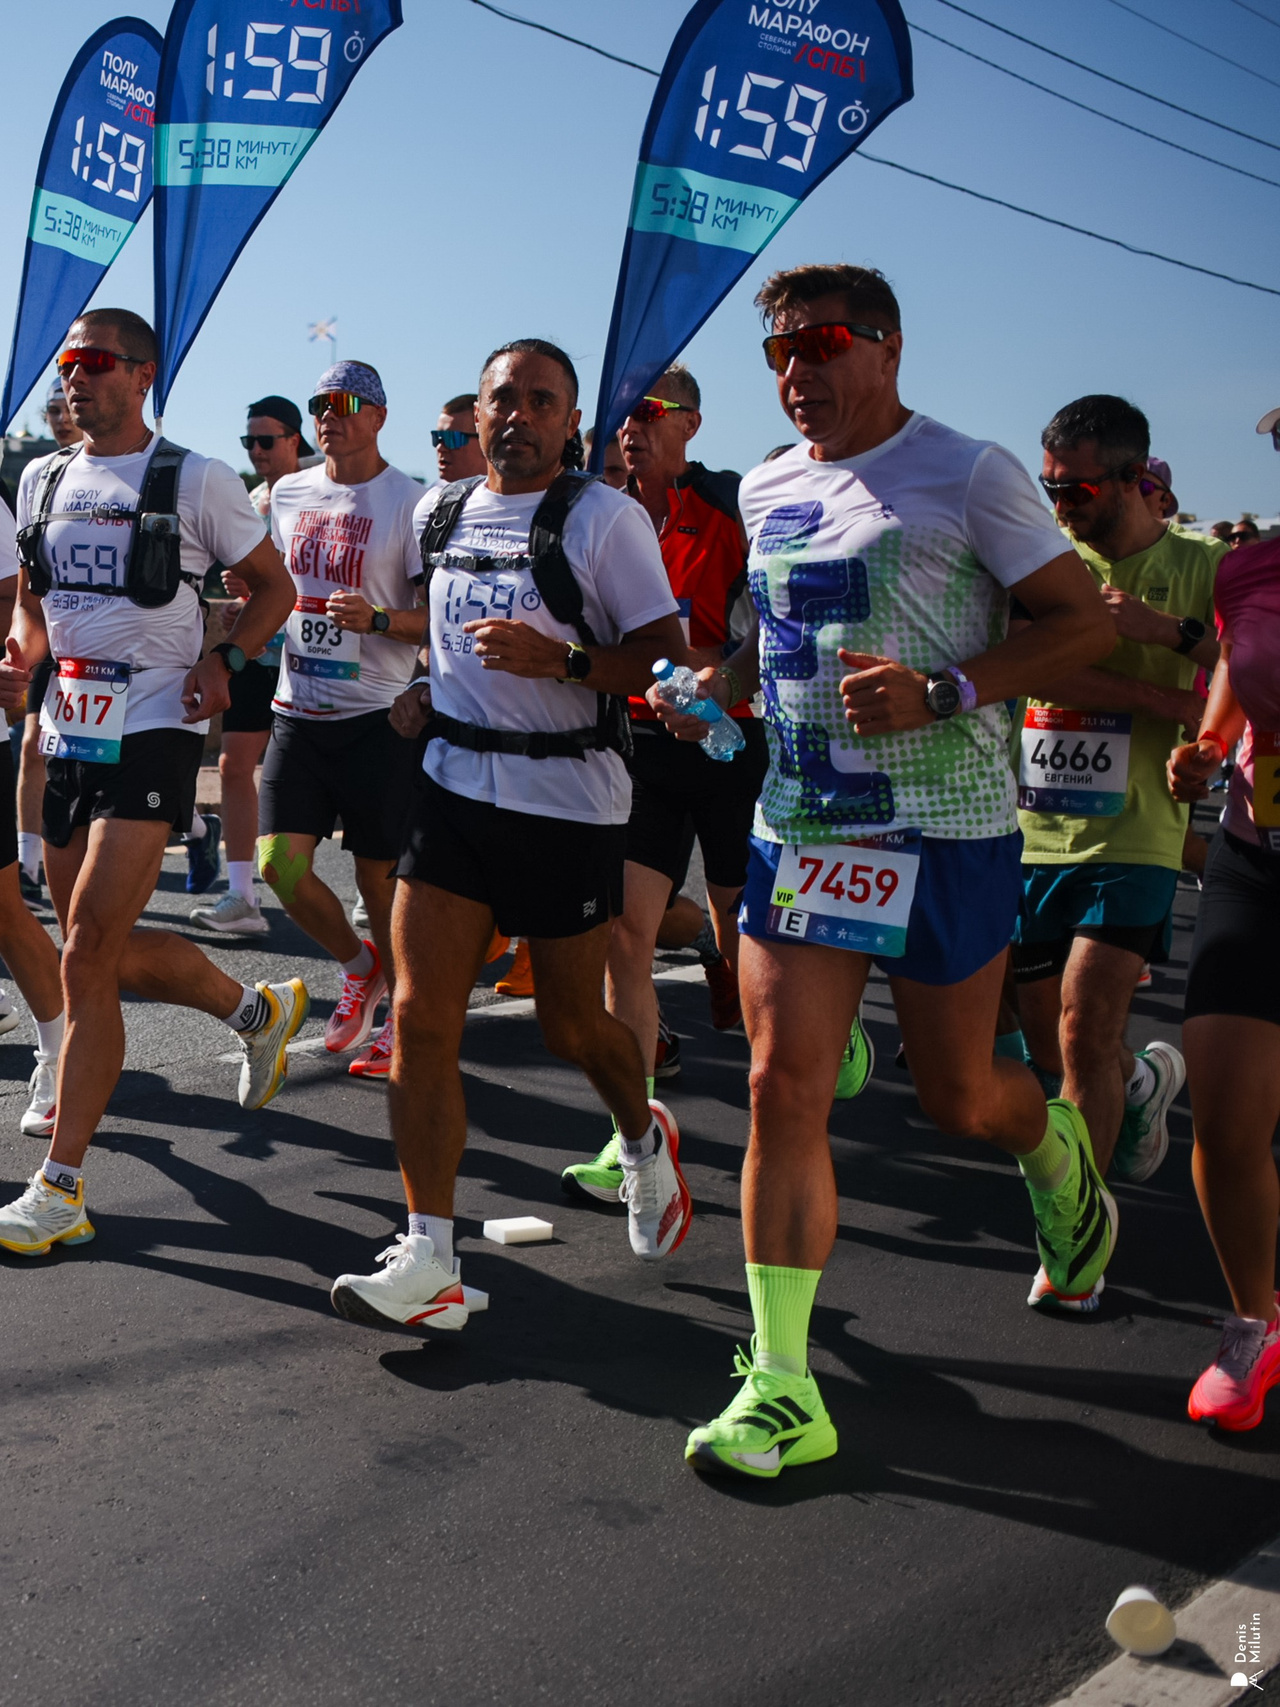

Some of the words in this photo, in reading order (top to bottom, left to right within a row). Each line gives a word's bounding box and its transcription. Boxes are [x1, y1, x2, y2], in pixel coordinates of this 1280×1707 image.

[748, 4, 870, 56] МАРАФОН
[759, 32, 797, 48] СЕВЕРНАЯ
[757, 41, 792, 56] СТОЛИЦА
[102, 50, 139, 80] ПОЛУ
[206, 22, 332, 104] 1:59
[100, 69, 156, 109] МАРАФО
[694, 65, 828, 173] 1:59
[71, 115, 146, 203] 1:59
[179, 138, 231, 170] 5:38
[235, 155, 258, 170] КМ
[650, 183, 709, 225] 5:38
[44, 205, 83, 242] 5:38
[711, 215, 738, 232] КМ
[81, 233, 96, 249] КМ
[67, 489, 102, 500] ПОЛУ
[472, 525, 510, 538] ПОЛУ
[50, 544, 118, 587] 1:59
[291, 536, 366, 589] БЕГАЛИ
[301, 618, 343, 647] 893
[307, 646, 333, 656] БОРИС
[441, 633, 473, 655] 5:38
[85, 665, 100, 675] 21,1
[101, 667, 116, 676] КМ
[54, 690, 114, 726] 7617
[1080, 717, 1097, 726] 21,1
[1100, 719, 1116, 727] КМ
[46, 735, 56, 752] E
[1030, 738, 1113, 774] 4666
[1044, 773, 1093, 785] ЕВГЕНИЙ
[1026, 790, 1037, 807] D
[886, 833, 905, 844] КМ
[798, 856, 899, 907] 7459
[776, 890, 794, 904] VIP
[785, 911, 803, 933] E
